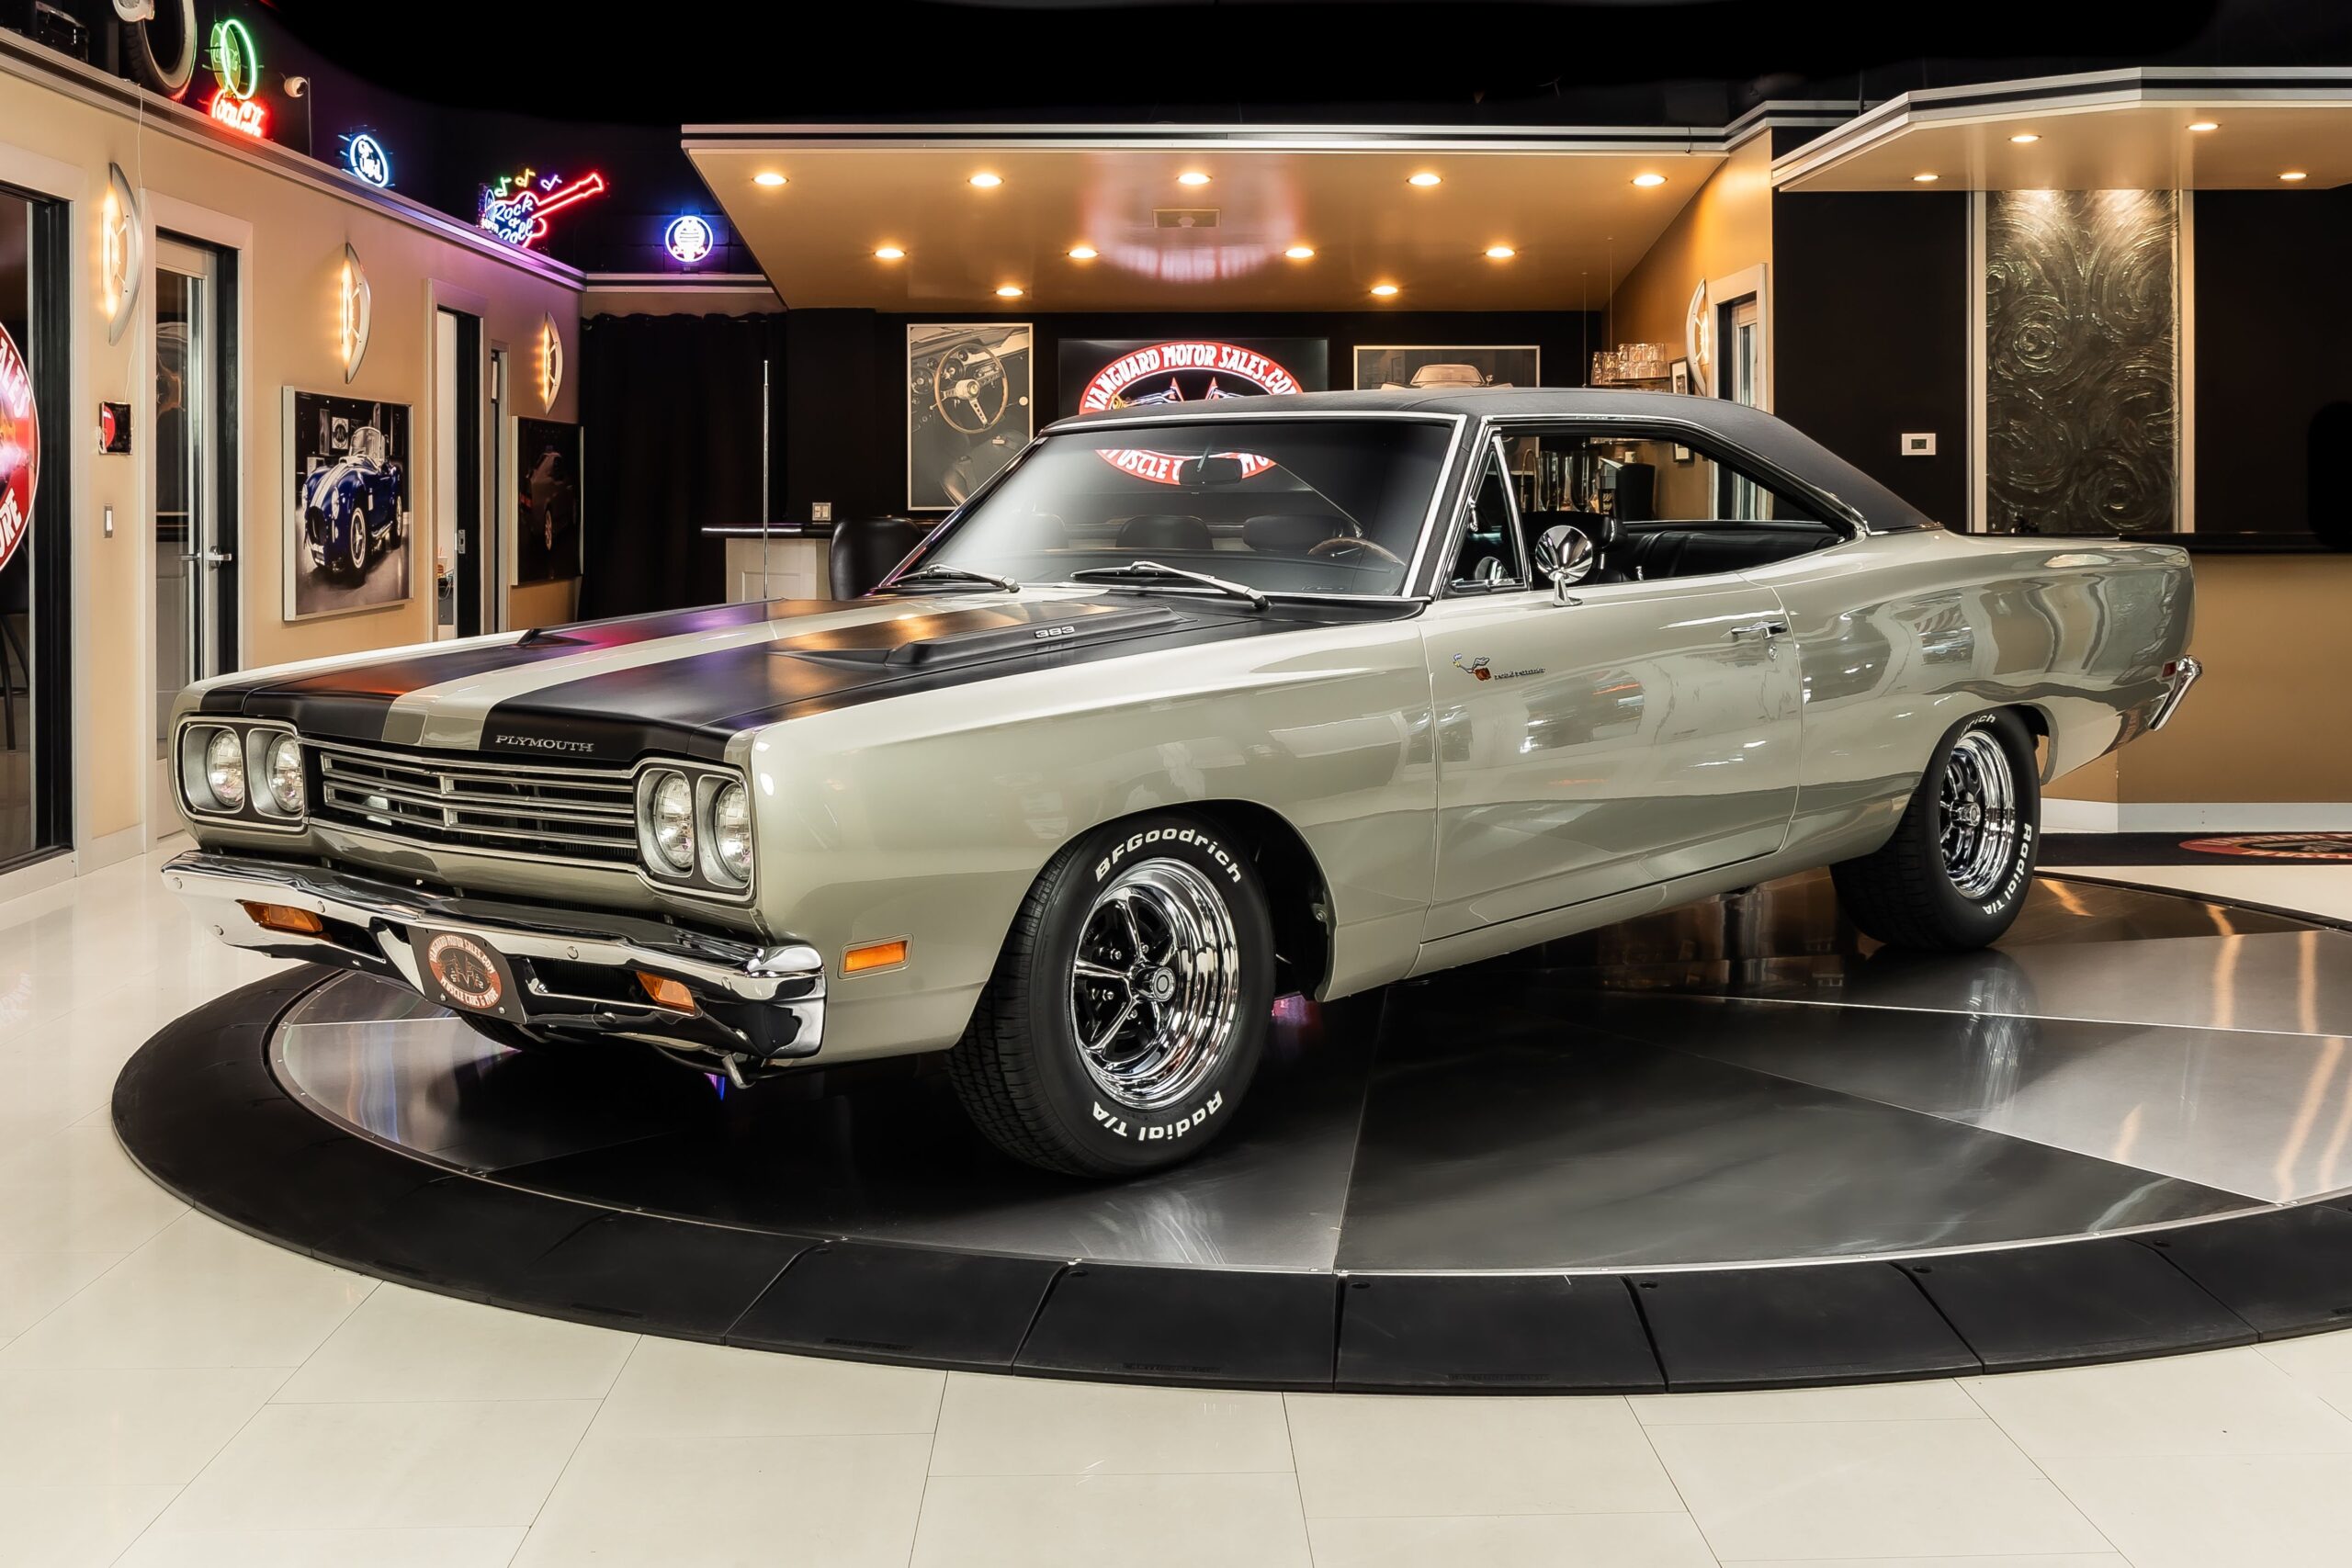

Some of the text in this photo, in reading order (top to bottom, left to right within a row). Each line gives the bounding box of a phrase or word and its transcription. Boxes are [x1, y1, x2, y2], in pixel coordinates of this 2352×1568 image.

[493, 193, 535, 222] Rock
[0, 337, 31, 419] ALES
[1085, 350, 1161, 411] VANGUARD
[1160, 344, 1217, 368] MOTOR
[1035, 626, 1075, 638] 383
[495, 735, 595, 752] PLYMOUTH
[1095, 829, 1241, 884] BFGoodrich
[2004, 823, 2033, 901] Radial
[464, 939, 496, 974] SALES.COM
[441, 976, 465, 1002] MUSCLE
[1092, 1090, 1223, 1141] Radial T/A
